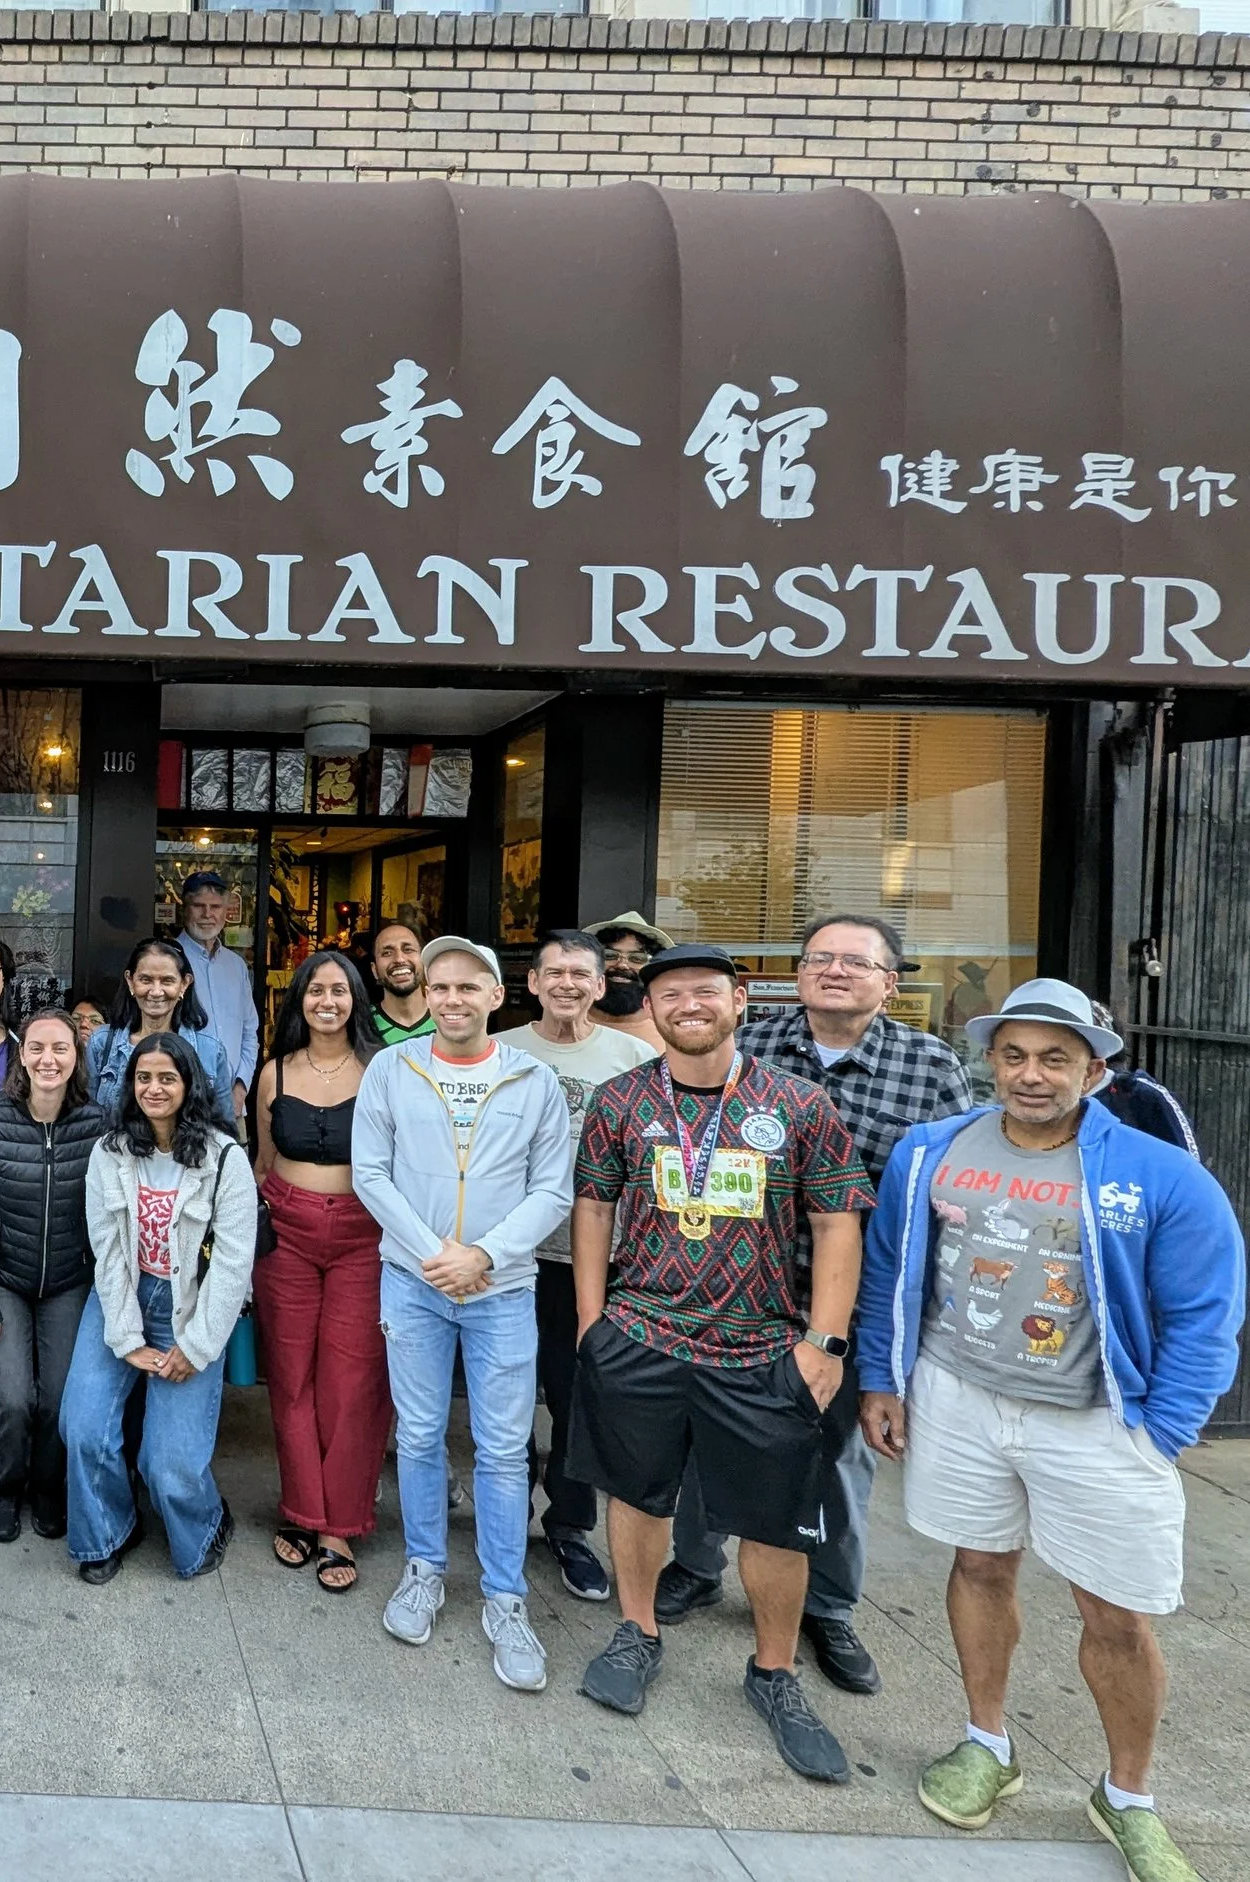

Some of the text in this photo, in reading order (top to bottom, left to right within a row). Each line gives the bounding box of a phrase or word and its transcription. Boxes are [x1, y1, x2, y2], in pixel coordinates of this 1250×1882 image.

[881, 448, 1238, 522] 健康是你
[578, 562, 1249, 668] RESTAUR
[103, 750, 135, 772] 1116
[710, 1171, 752, 1193] 390
[935, 1165, 950, 1185] I
[953, 1168, 1001, 1193] AM
[1099, 1209, 1145, 1228] ARLIE'S
[1101, 1219, 1131, 1233] CRES
[975, 1287, 1000, 1300] SPORT
[1033, 1301, 1071, 1314] MEDICINE
[964, 1334, 996, 1349] NUGGETS
[1025, 1354, 1058, 1366] TROPHY
